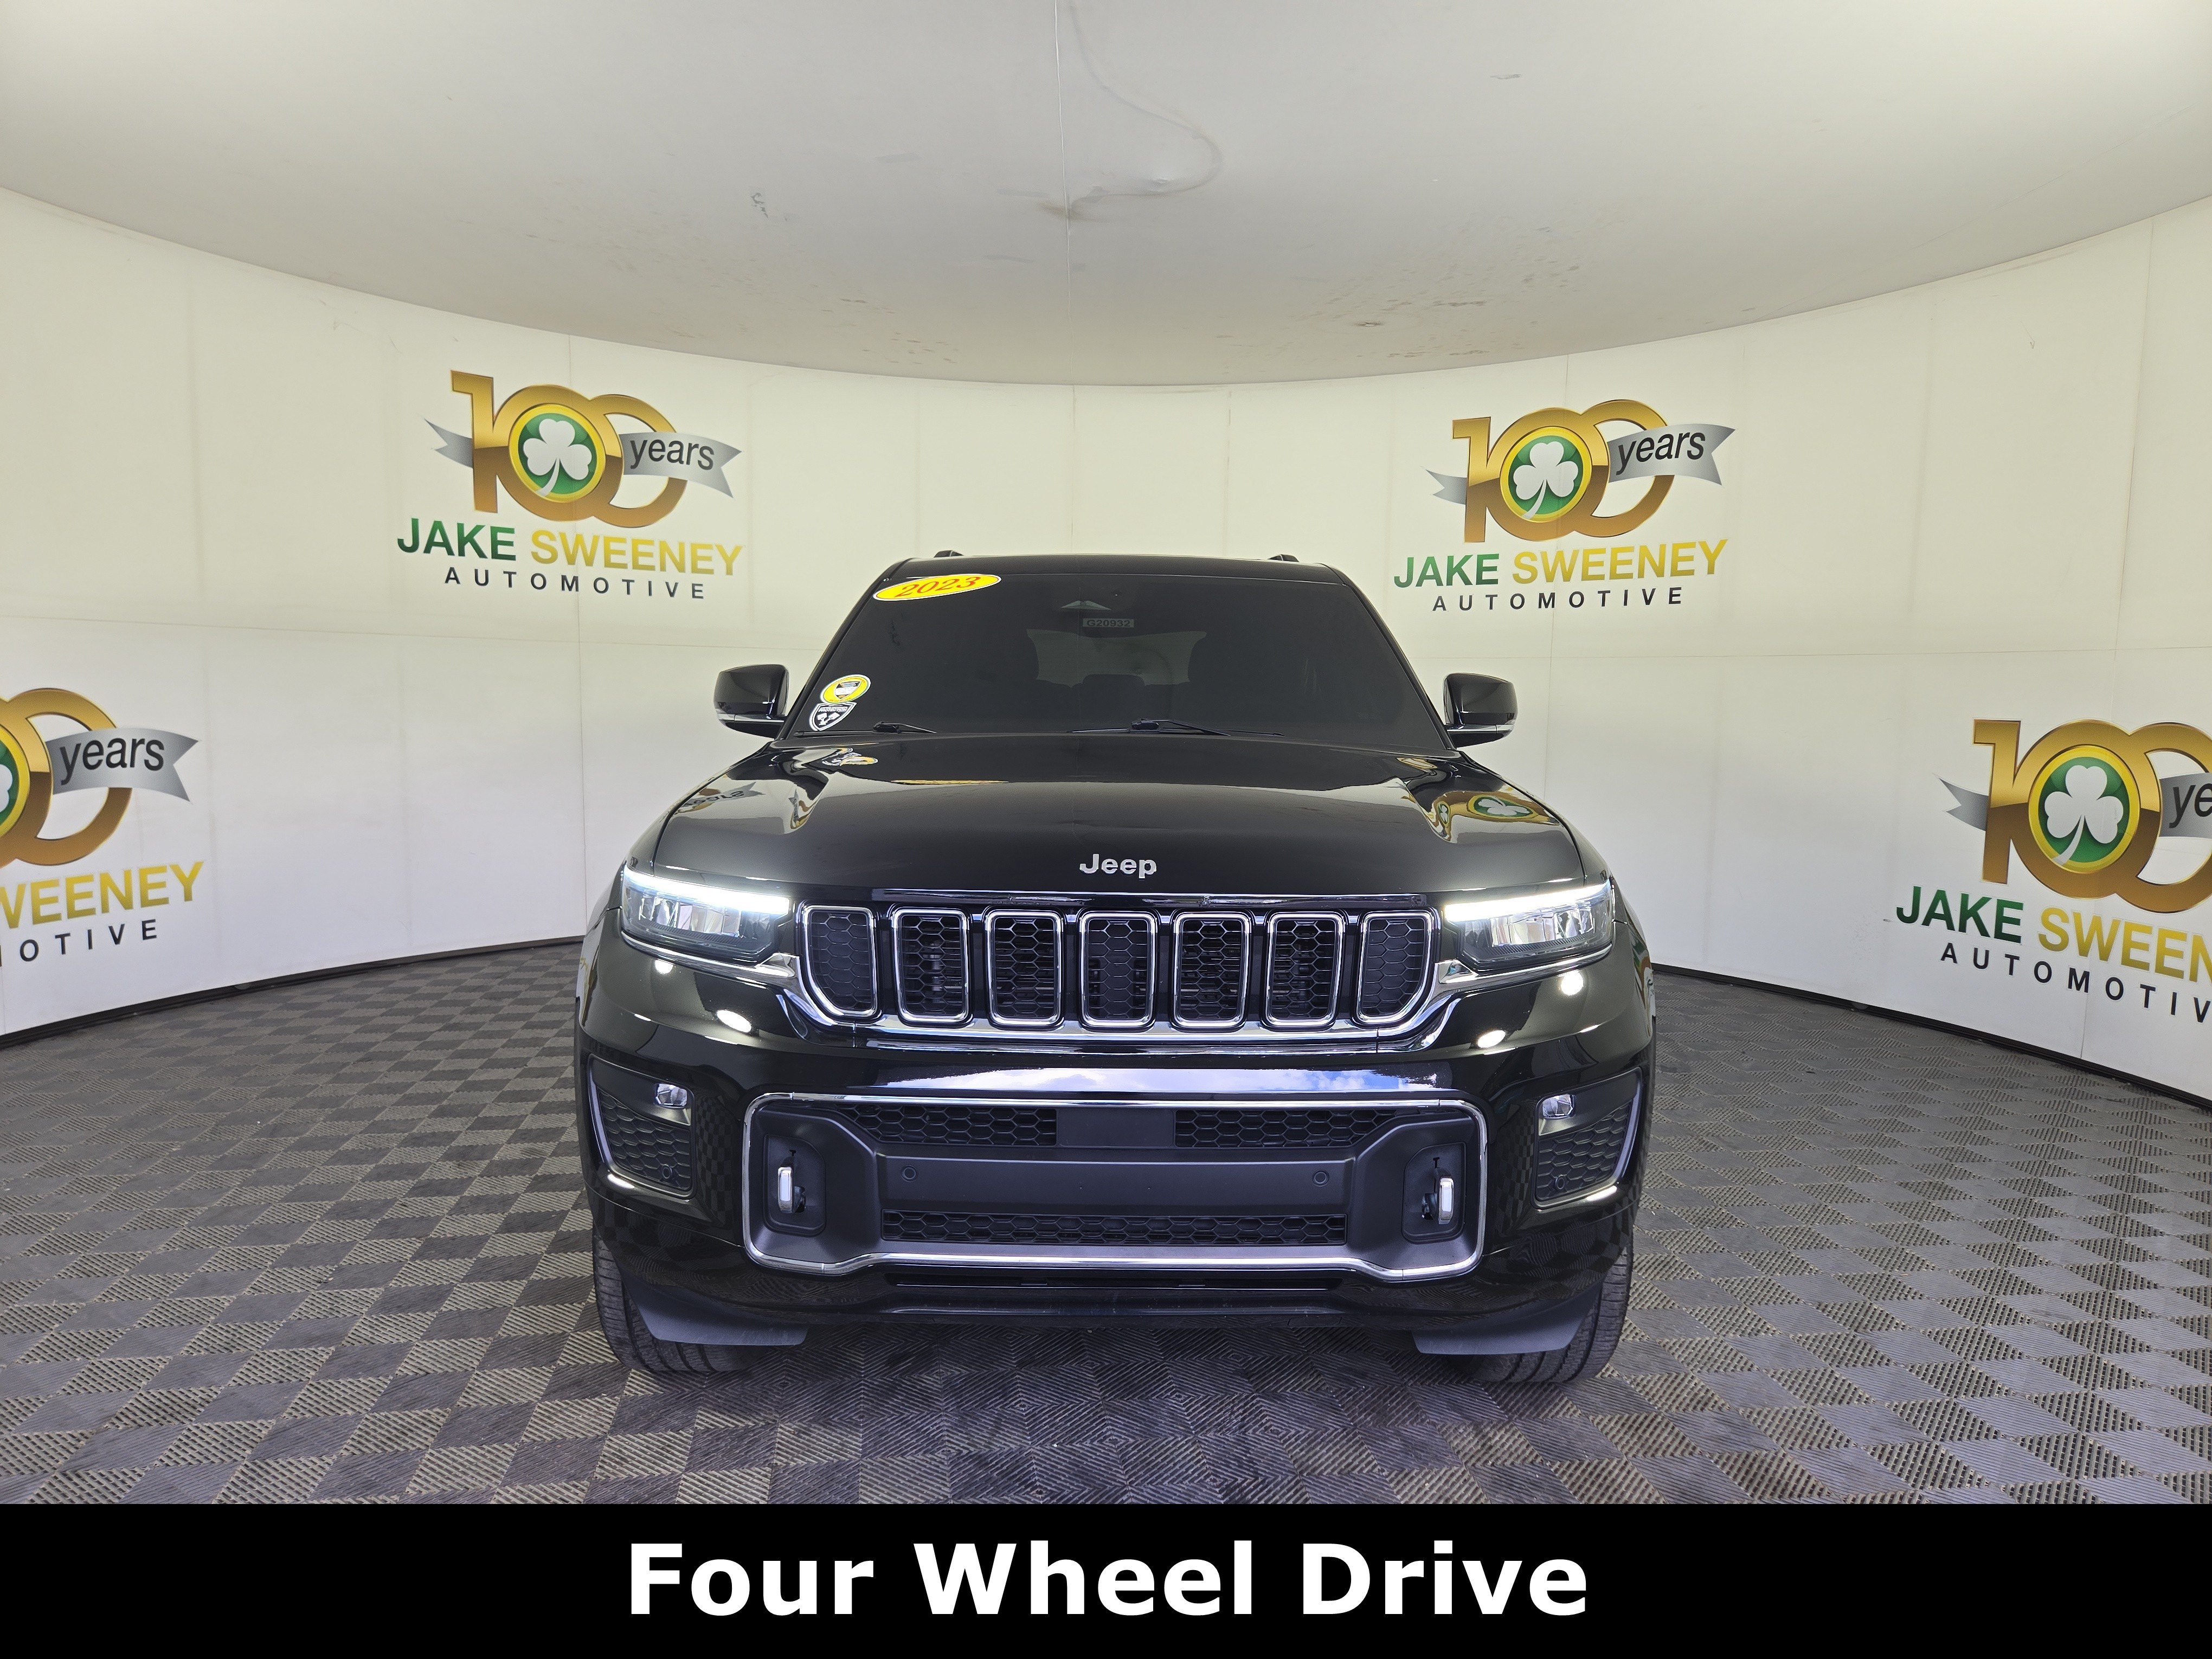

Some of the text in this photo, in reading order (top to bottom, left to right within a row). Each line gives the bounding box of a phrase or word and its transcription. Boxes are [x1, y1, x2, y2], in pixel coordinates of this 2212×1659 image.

[629, 438, 714, 470] years
[1616, 432, 1706, 475] years
[397, 518, 743, 576] JAKE SWEENEY
[1394, 539, 1728, 588] JAKE SWEENEY
[445, 567, 704, 599] AUTOMOTIVE
[895, 576, 981, 597] 2023
[1432, 587, 1682, 611] AUTOMOTIVE
[60, 736, 164, 786] years
[1079, 853, 1157, 879] Jeep
[1896, 886, 2023, 944] JAKE
[0, 919, 157, 967] OTIVE
[1940, 943, 2211, 1024] AUTOMOTIV
